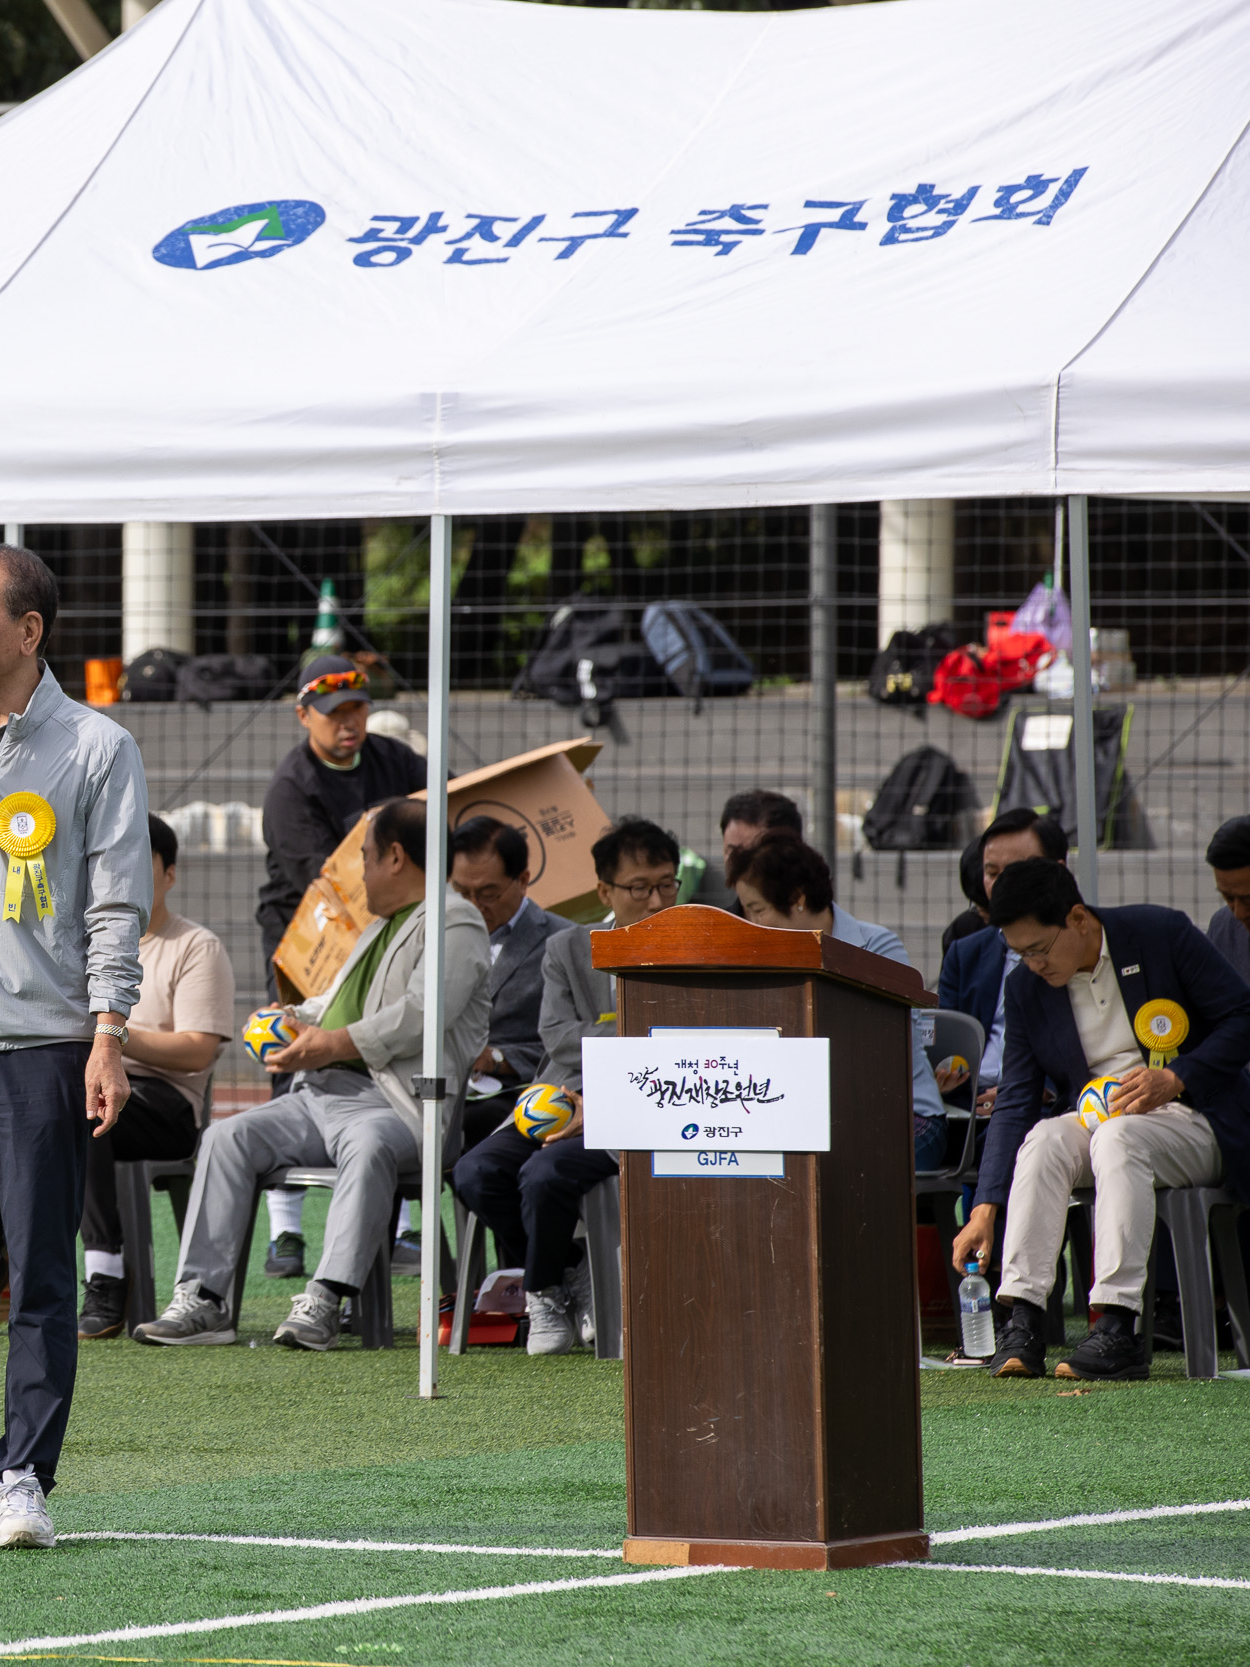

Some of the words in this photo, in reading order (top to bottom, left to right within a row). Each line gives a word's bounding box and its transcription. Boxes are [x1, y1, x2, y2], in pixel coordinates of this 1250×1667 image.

[345, 206, 640, 268] 광진구
[668, 165, 1090, 257] 축구협회
[674, 1058, 699, 1075] 개청
[703, 1055, 739, 1076] 30주년
[703, 1125, 744, 1139] 광진구
[697, 1151, 739, 1167] GJFA
